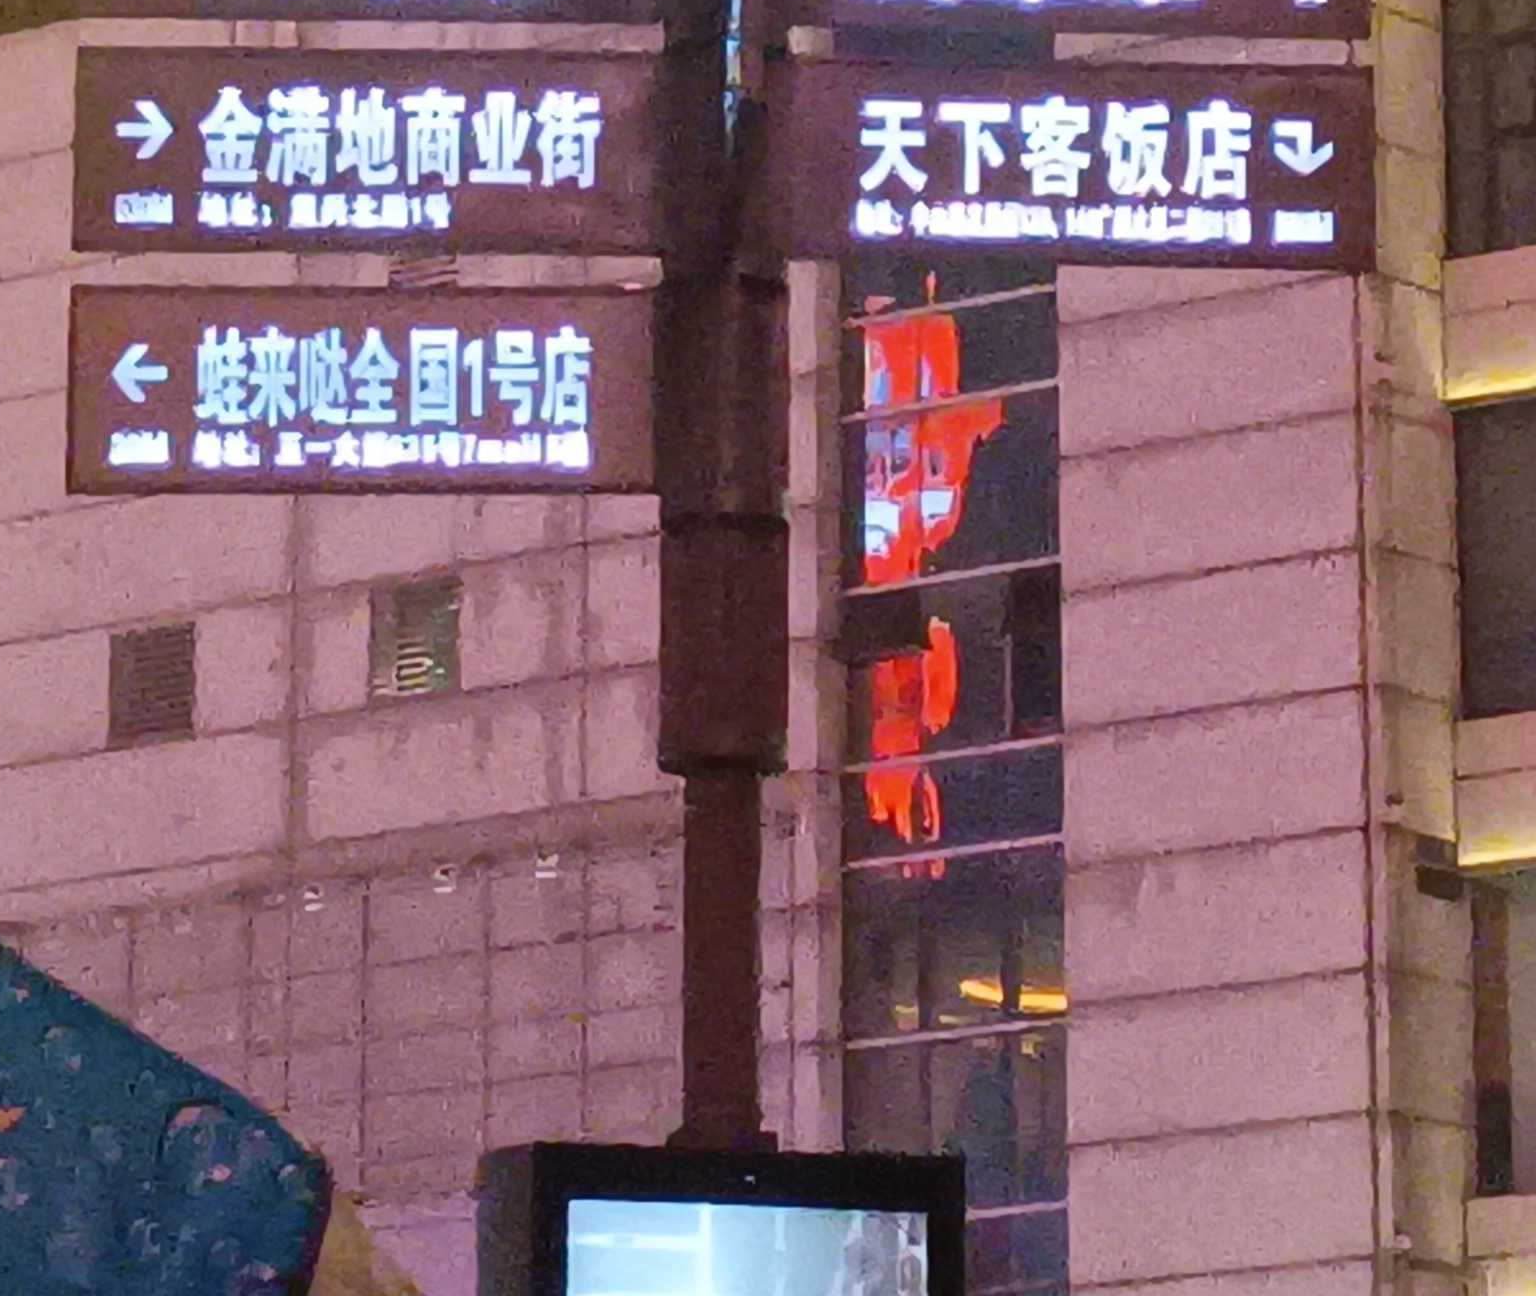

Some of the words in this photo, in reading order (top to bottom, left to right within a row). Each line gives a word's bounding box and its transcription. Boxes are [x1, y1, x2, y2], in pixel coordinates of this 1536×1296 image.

[198, 86, 601, 188] 金满地商业街
[859, 95, 1252, 200] 天下客饭店
[193, 325, 594, 427] 蛙来哒全国1号店
